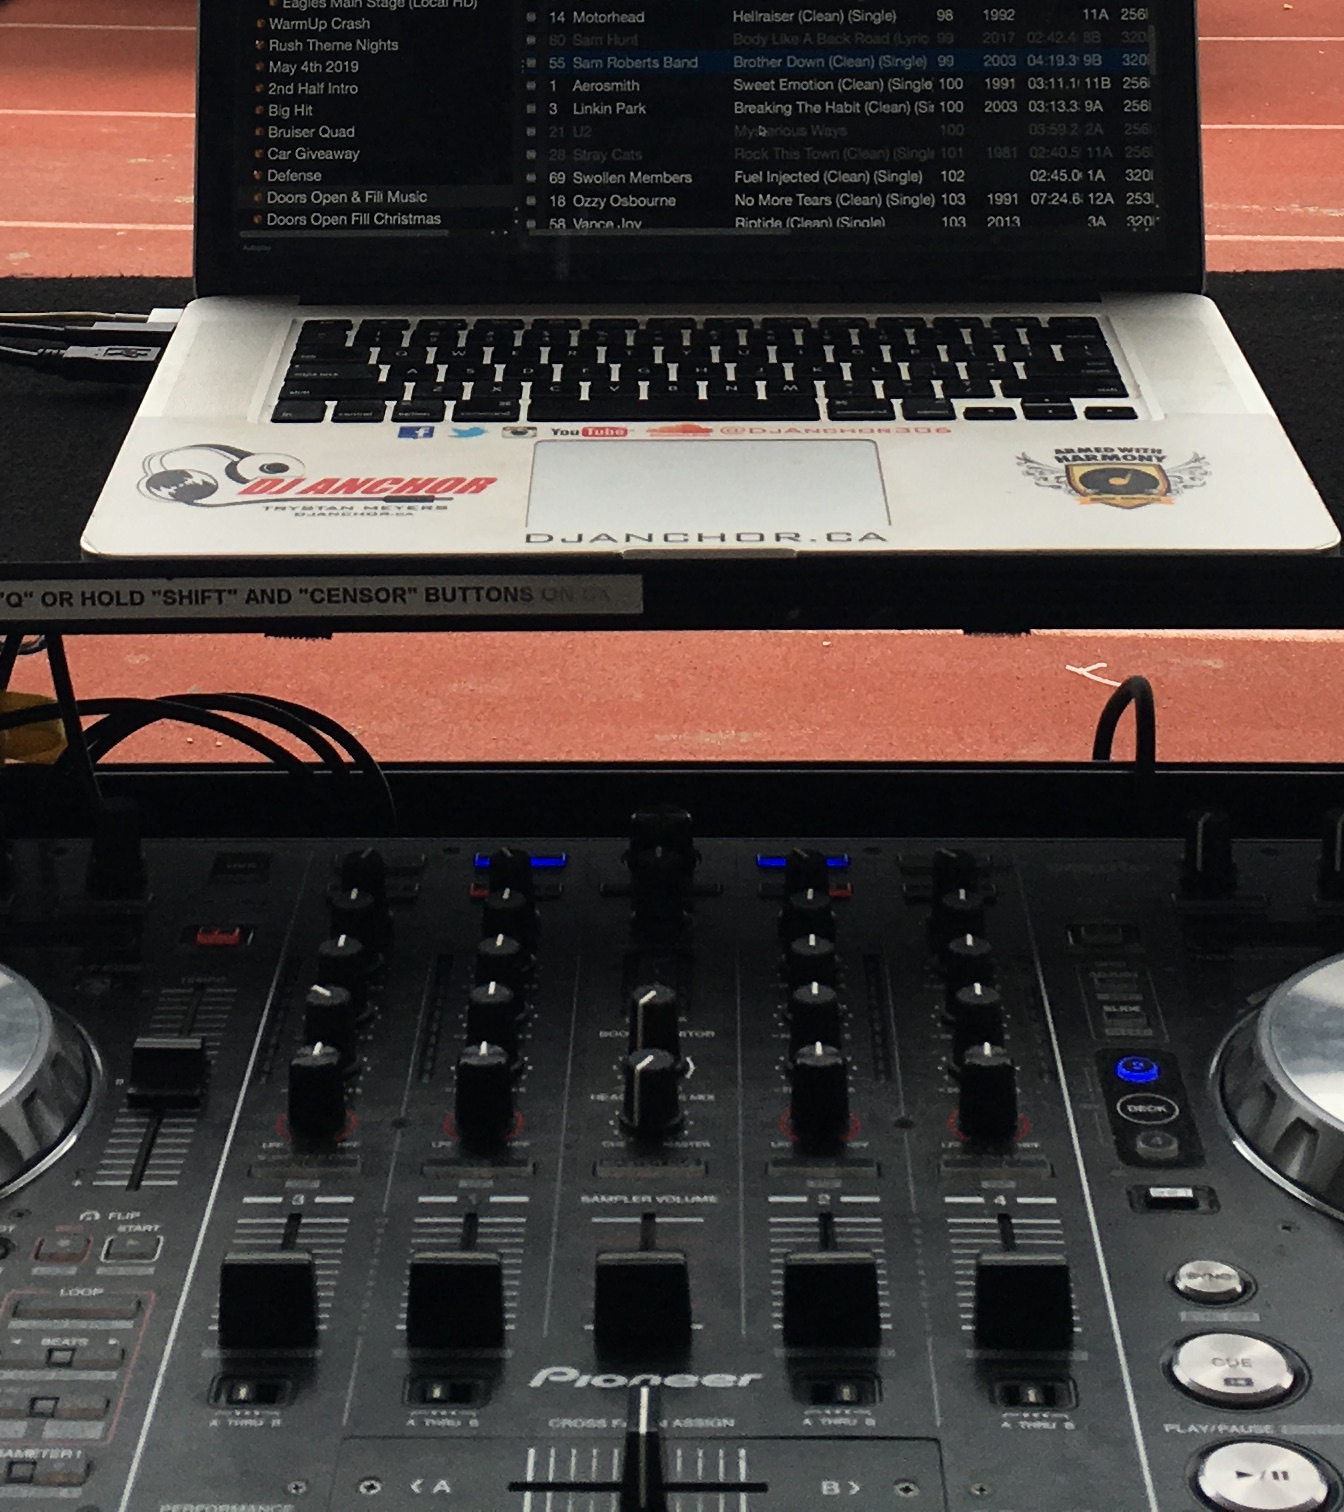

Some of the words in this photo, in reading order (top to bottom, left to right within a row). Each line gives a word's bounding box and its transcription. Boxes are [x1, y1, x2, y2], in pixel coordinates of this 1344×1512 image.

[572, 10, 646, 24] Motorhead
[732, 9, 795, 23] Hellraiser
[268, 17, 328, 33] WarmUp
[330, 16, 371, 31] Crash
[269, 38, 304, 52] Rush
[306, 38, 353, 52] Theme
[355, 38, 399, 55] Nights
[268, 60, 298, 77] May
[300, 60, 323, 73] 4th
[325, 60, 360, 73] 2019
[572, 56, 604, 70] Sam
[606, 55, 660, 69] Roberts
[662, 55, 699, 69] Band
[733, 55, 783, 69] Brother
[786, 55, 825, 69] Down
[267, 82, 295, 96] 2nd
[297, 81, 325, 95] Half
[327, 81, 359, 95] Intro
[571, 79, 641, 93] Aerosmith
[733, 77, 776, 92] Sweet
[778, 77, 835, 92] Emotion
[268, 103, 291, 120] Big
[294, 103, 314, 117] Hit
[573, 102, 613, 115] Linkin
[615, 101, 647, 115] Park
[733, 100, 793, 117] Breaking
[795, 100, 822, 114] The
[824, 100, 861, 114] Habit
[267, 125, 316, 139] Bruiser
[318, 124, 356, 139] Quad
[267, 147, 292, 161] Car
[294, 146, 361, 163] Giveaway
[267, 168, 323, 182] Defense
[572, 170, 626, 185] Swollen
[629, 170, 693, 184] Members
[734, 170, 763, 184] Fuel
[766, 170, 820, 186] Injected
[267, 190, 308, 204] Doors
[310, 190, 348, 207] Open
[350, 190, 362, 204] &
[364, 190, 384, 203] Fill
[387, 190, 428, 204] Music
[572, 194, 607, 211] Ozzy
[609, 193, 677, 208] Osbourne
[734, 193, 755, 207] No
[758, 193, 794, 207] More
[795, 192, 833, 207] Tears
[266, 212, 307, 226] Doors
[310, 212, 348, 228] Open
[350, 212, 371, 225] Fill
[373, 211, 442, 226] Christmas
[1117, 446, 1163, 454] WITH
[1054, 454, 1168, 463] HARMONY
[237, 476, 299, 495] DJ
[304, 476, 498, 495] ANCHOR
[525, 531, 889, 544] DJANCHOR.CA
[41, 591, 74, 608] OR
[81, 590, 145, 607] HOLD
[152, 589, 238, 606] "SHIFT"
[245, 588, 293, 605] AND
[298, 587, 418, 605] "CENSOR"
[424, 586, 534, 604] BUTTONS
[528, 1366, 765, 1389] Pioneer
